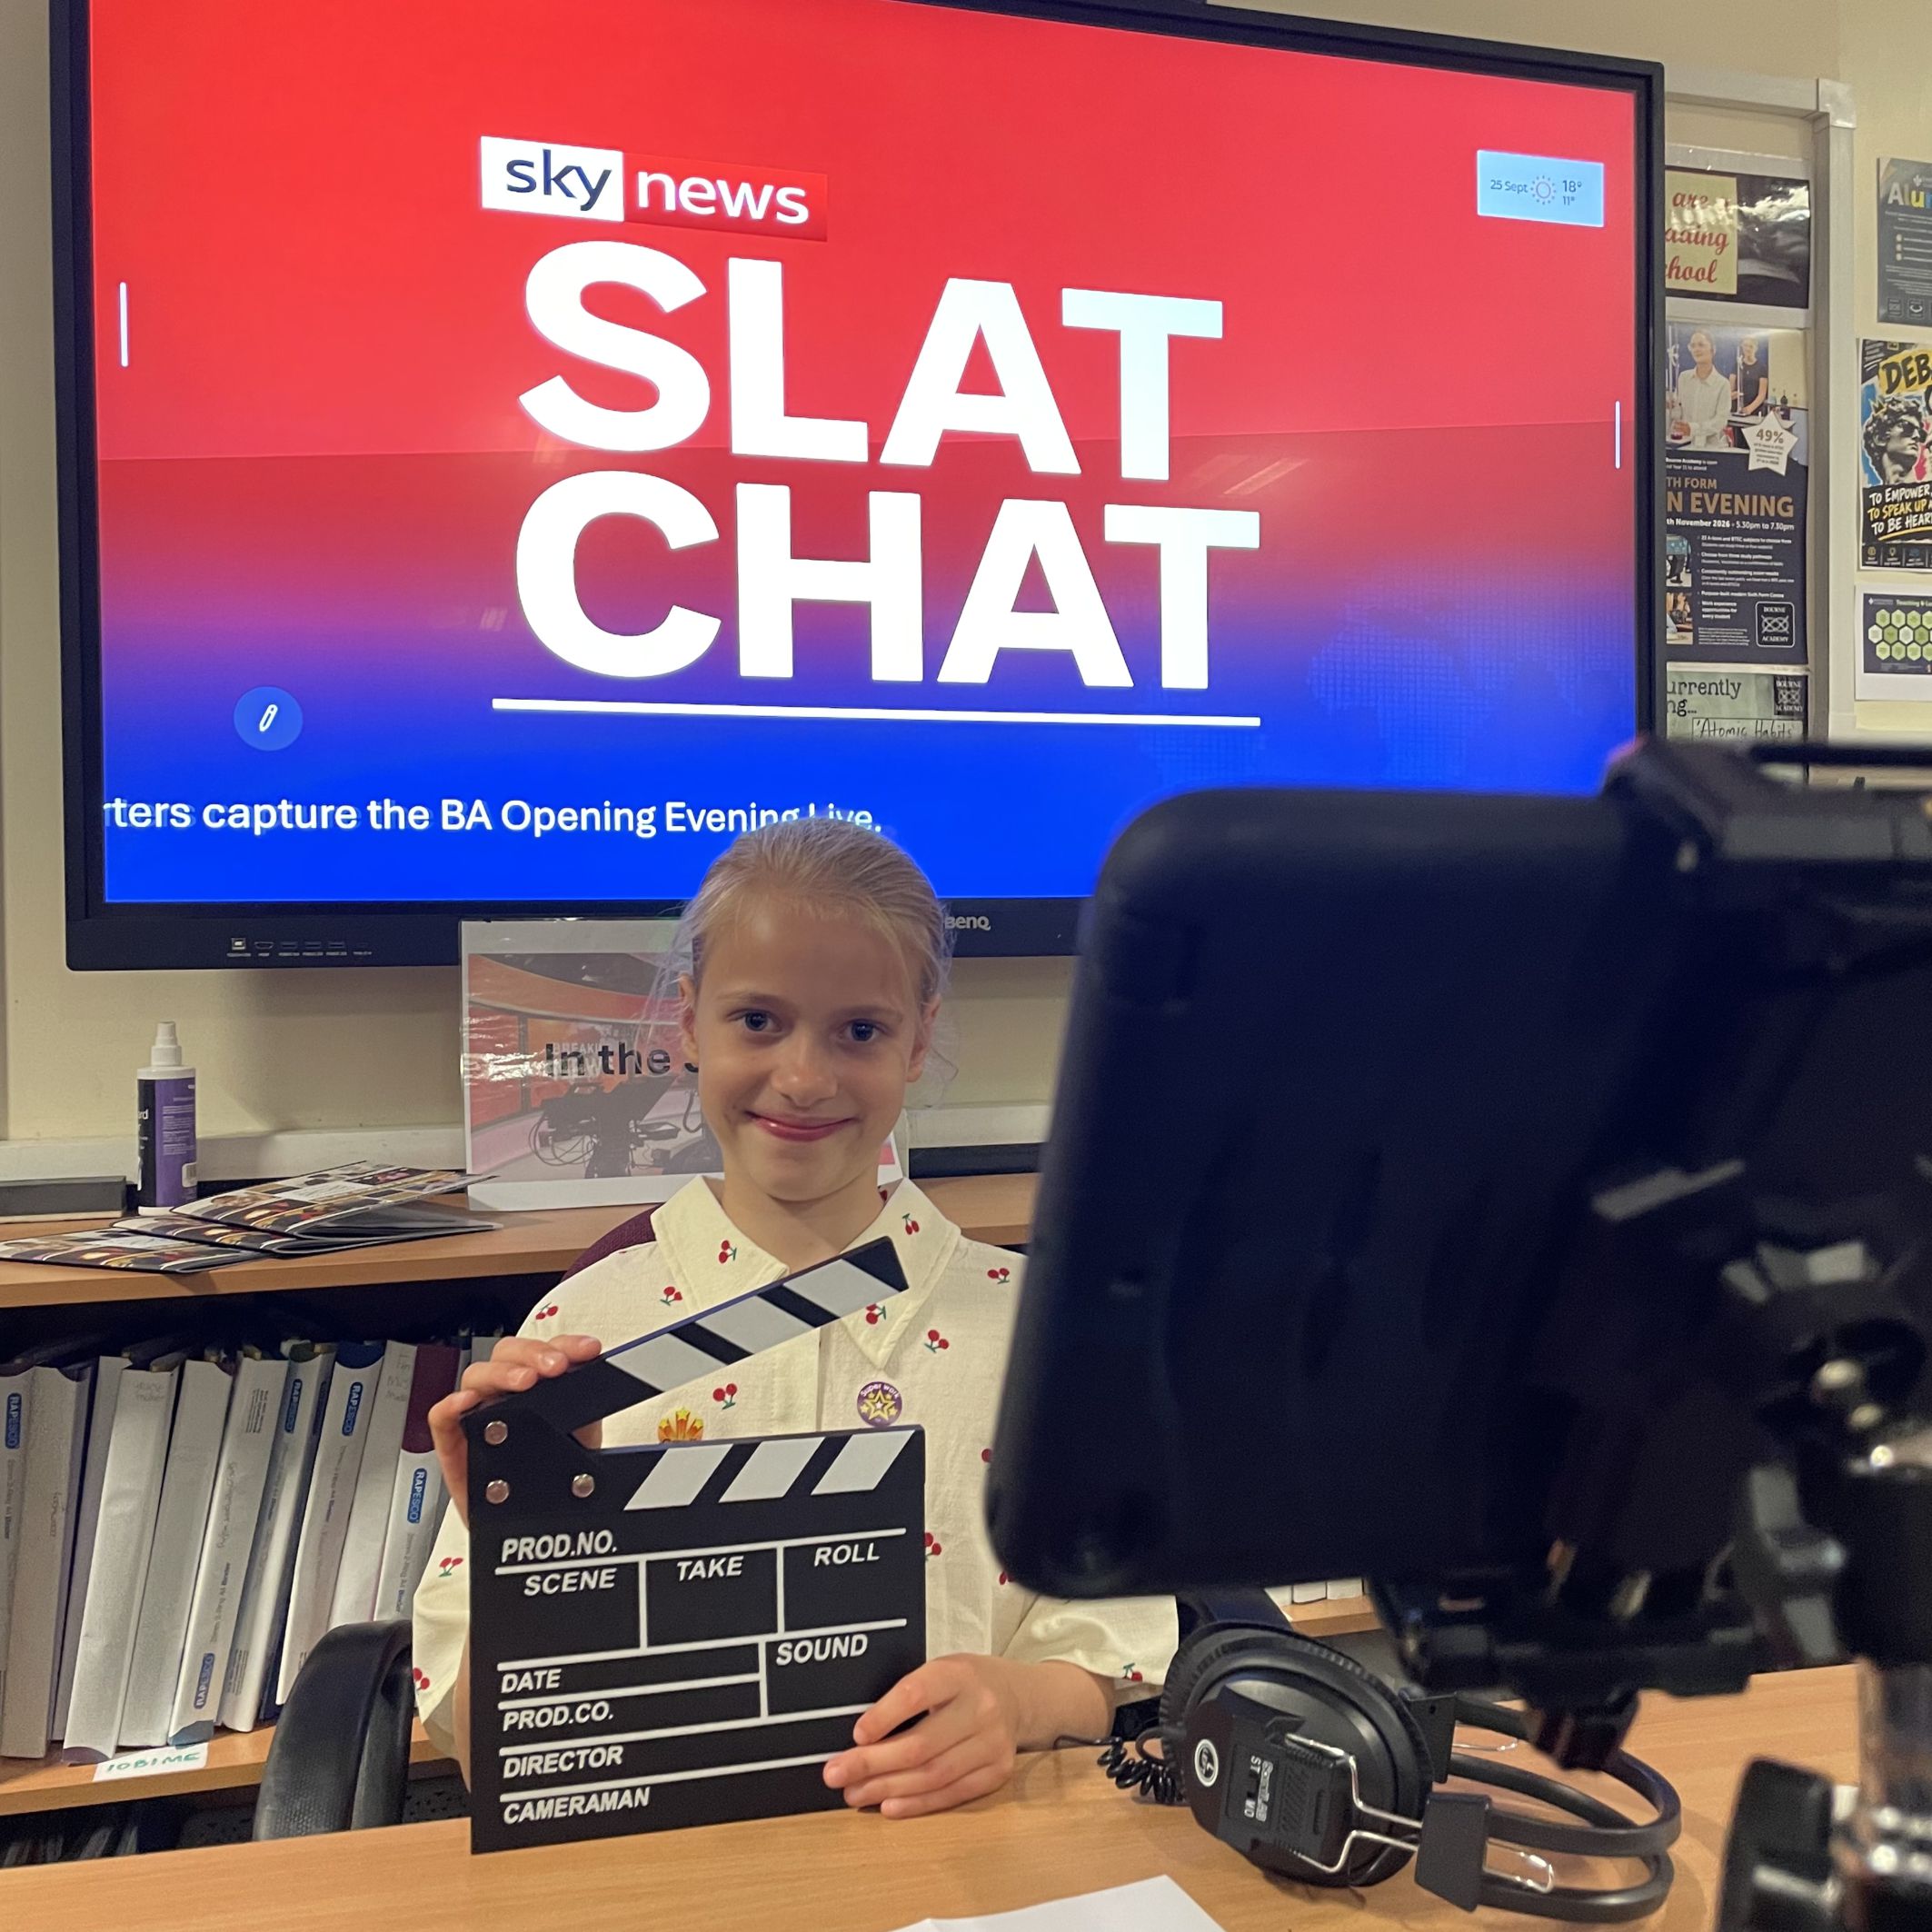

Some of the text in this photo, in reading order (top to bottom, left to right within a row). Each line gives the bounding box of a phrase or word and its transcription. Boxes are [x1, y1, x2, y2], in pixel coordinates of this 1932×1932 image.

[506, 148, 811, 224] sky news
[1490, 180, 1502, 190] 25
[1505, 182, 1529, 194] Sept
[1665, 255, 1718, 284] hool
[519, 241, 1223, 481] SLAT
[1882, 354, 1932, 394] DEB
[1756, 428, 1784, 443] 49%
[1666, 476, 1717, 489] TH FORM
[1667, 492, 1794, 518] N EVENING
[1867, 507, 1880, 521] TO
[1882, 502, 1912, 519] SPEAK
[1914, 499, 1927, 512] UP
[1868, 493, 1882, 506] TO
[1676, 519, 1711, 527] November
[1713, 520, 1730, 528] 2026
[1871, 512, 1932, 535] TO BE HEAR
[516, 470, 1260, 690] CHAT
[1667, 678, 1742, 700] urrently
[203, 799, 357, 836] capture
[367, 798, 430, 830] the
[442, 800, 492, 831] BA
[501, 800, 657, 839] Opening
[598, 1041, 670, 1075] the
[408, 1470, 427, 1522] RAPESCO
[501, 1529, 618, 1562] PROD.NO.
[814, 1543, 881, 1567] ROLL
[523, 1568, 617, 1597] SCENE
[677, 1556, 744, 1581] TAKE
[776, 1634, 868, 1666] SOUND
[195, 1656, 213, 1708] RAPESCO
[501, 1668, 562, 1694] DATE
[503, 1701, 613, 1731] PROD.CO.
[503, 1746, 623, 1778] DIRECTOR
[503, 1787, 650, 1825] CAMERAMAN
